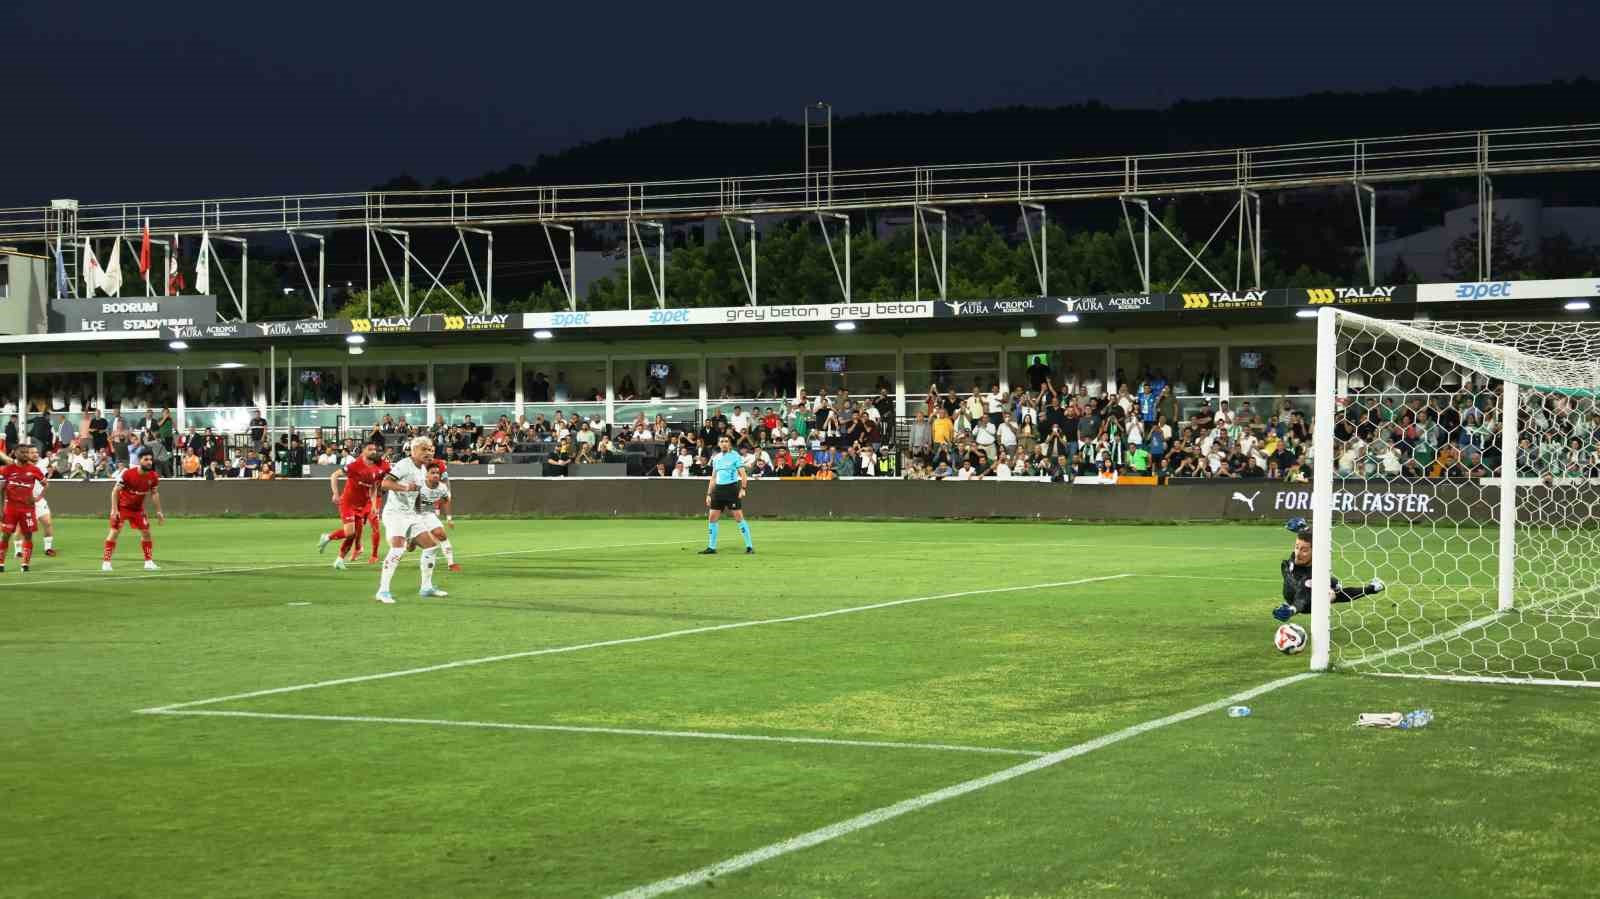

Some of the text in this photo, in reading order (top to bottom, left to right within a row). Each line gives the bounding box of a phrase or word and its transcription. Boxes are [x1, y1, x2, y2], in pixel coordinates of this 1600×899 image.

[1208, 290, 1268, 302] TALAY
[1336, 286, 1397, 298] TALAY
[993, 300, 1035, 309] ACROPOL
[1075, 301, 1104, 311] AURA
[1108, 296, 1152, 306] ACROPOL
[102, 302, 158, 313] BODRUM
[726, 305, 819, 321] grey beton
[830, 302, 927, 319] grey beton
[961, 304, 990, 314] AURA
[81, 319, 106, 331] İLÇE
[371, 318, 414, 327] TALAY
[465, 314, 509, 325] TALAY
[1362, 492, 1435, 513] FASTER.
